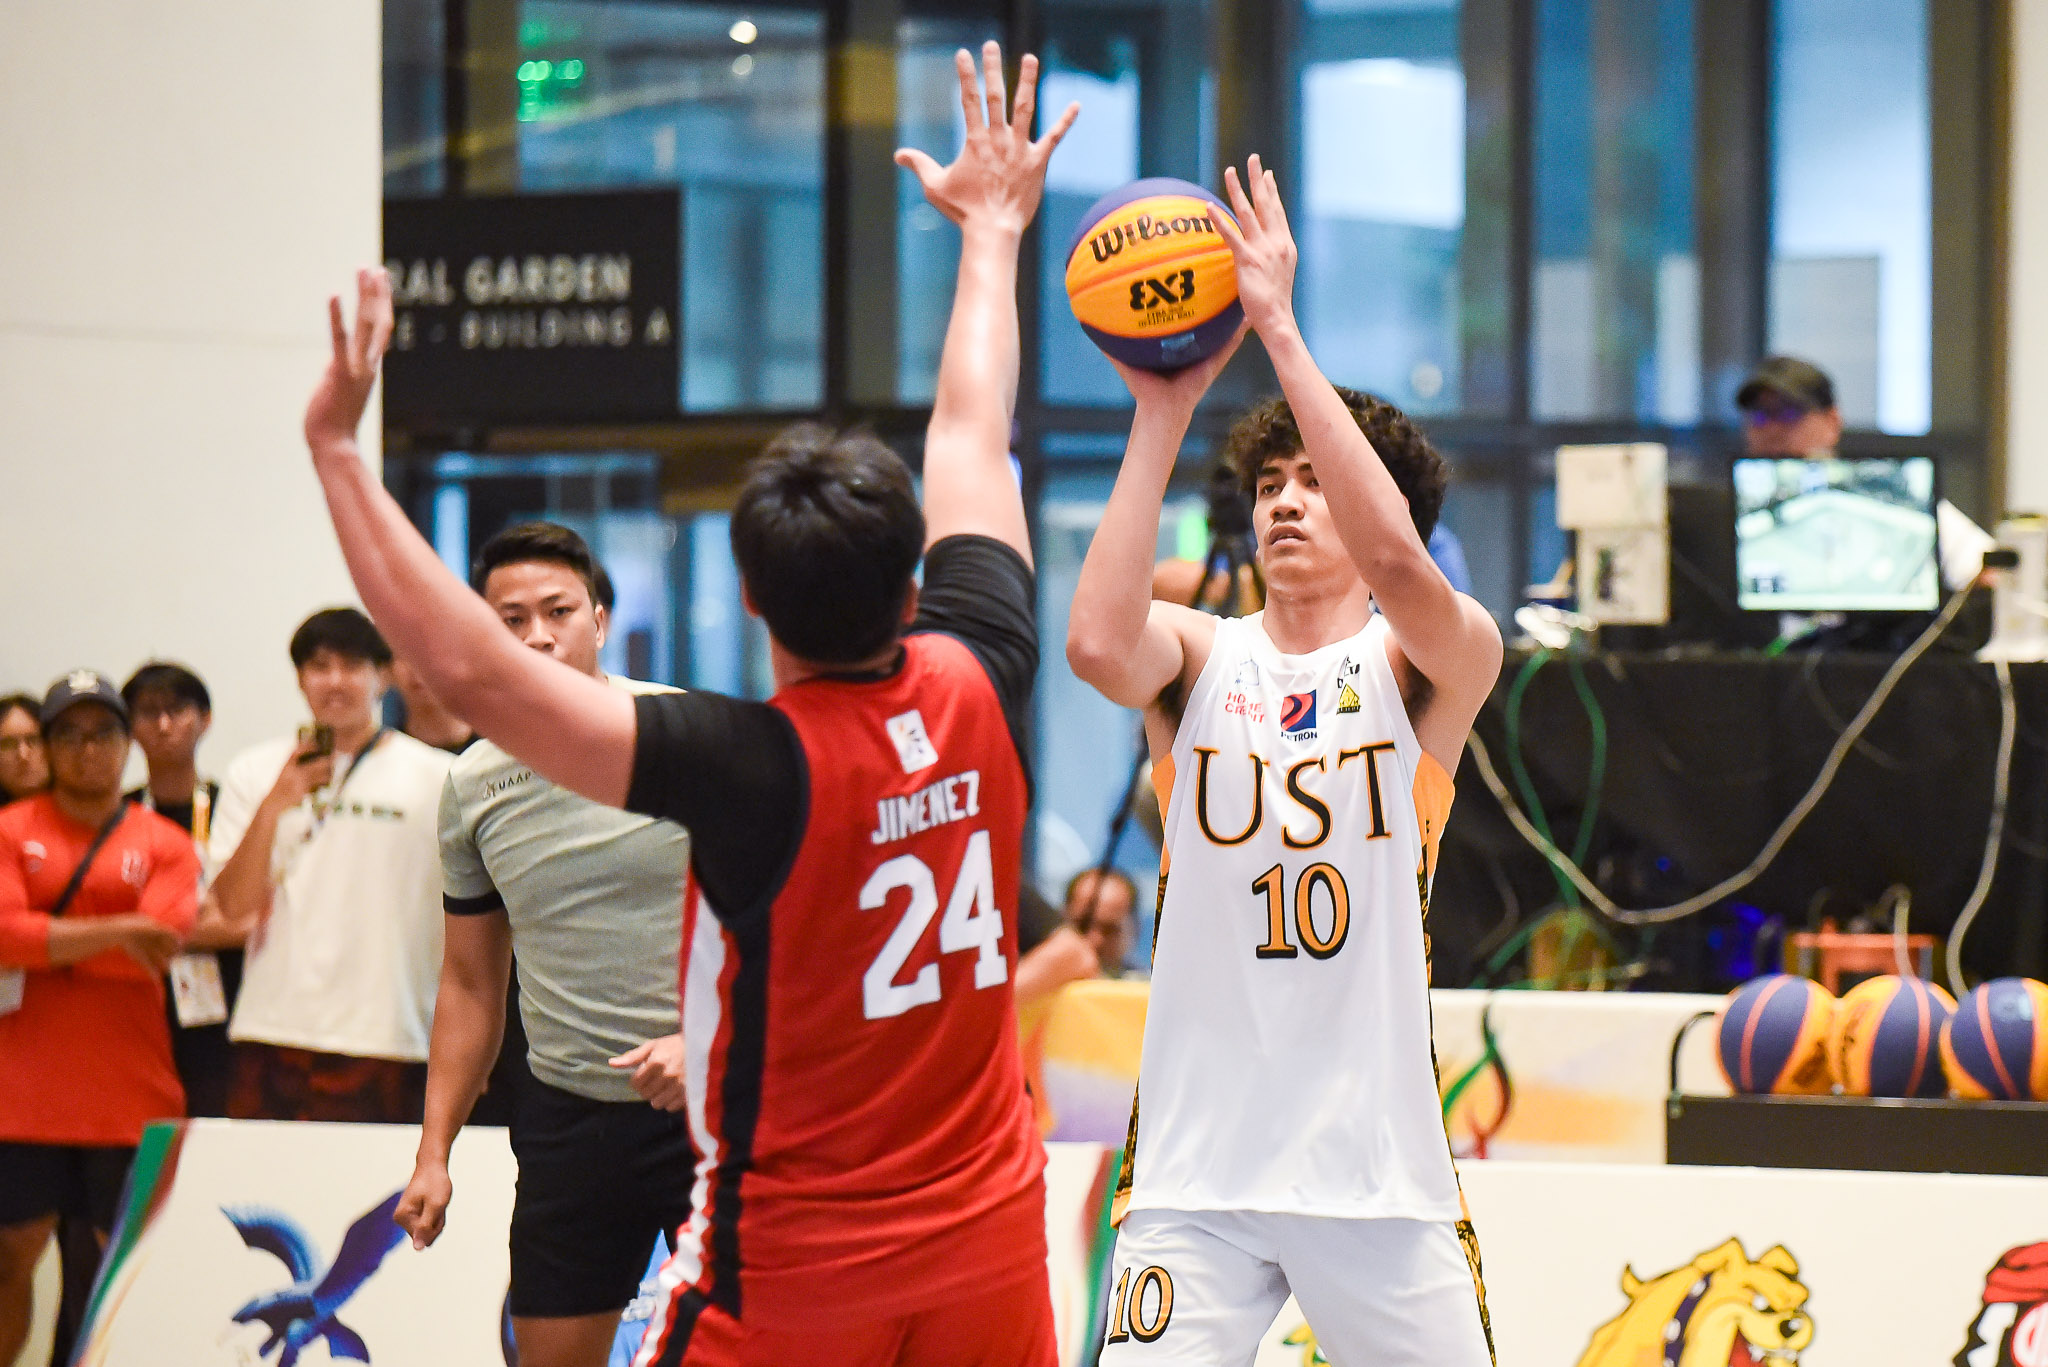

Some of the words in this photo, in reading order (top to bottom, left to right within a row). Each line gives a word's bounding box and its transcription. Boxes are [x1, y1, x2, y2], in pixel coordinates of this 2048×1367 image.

[1089, 213, 1215, 264] Wilson
[464, 252, 632, 305] GARDEN
[460, 307, 632, 350] BUILDING
[643, 305, 672, 346] A
[871, 769, 980, 845] JIMENEZ
[1193, 740, 1397, 851] UST
[858, 829, 1009, 1020] 24
[1251, 861, 1350, 960] 10
[1107, 1265, 1174, 1346] 10
